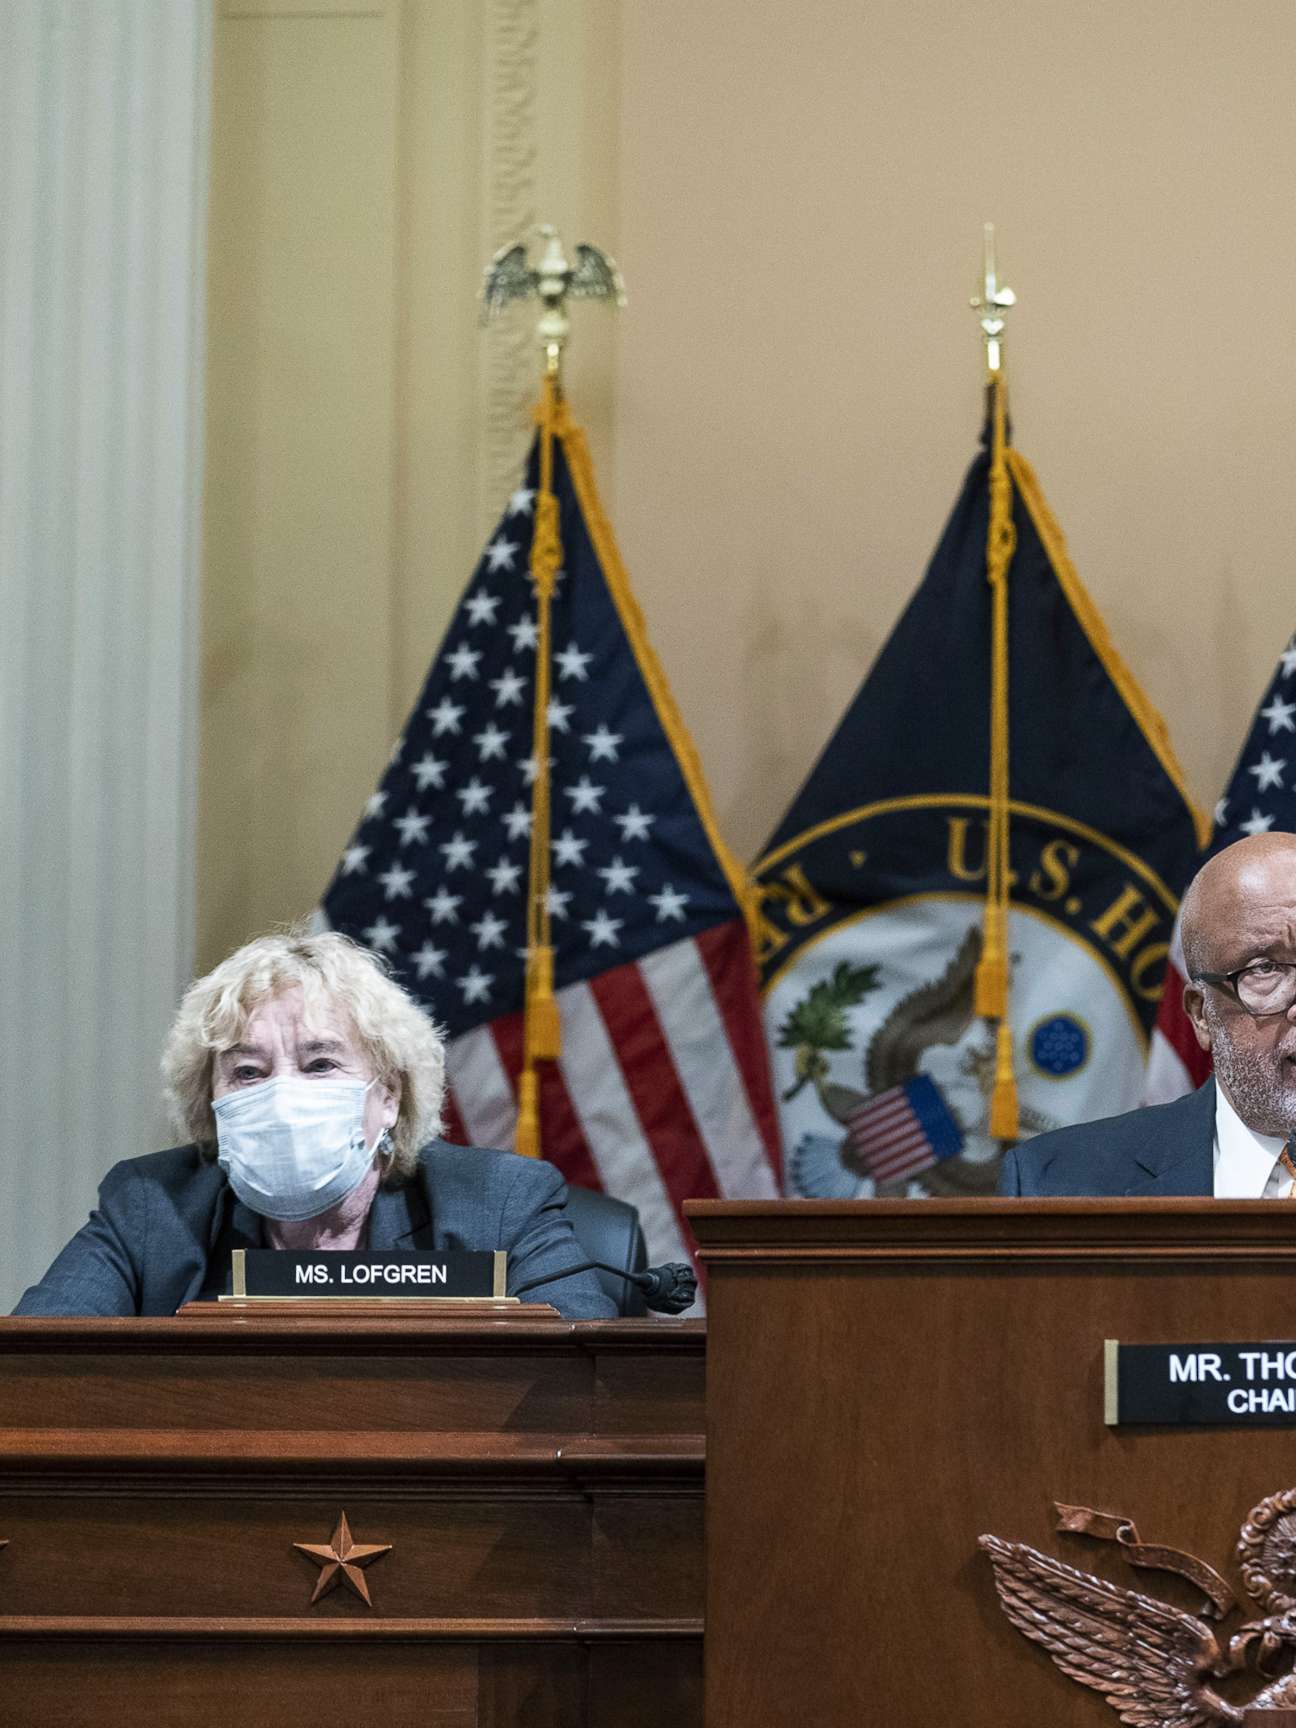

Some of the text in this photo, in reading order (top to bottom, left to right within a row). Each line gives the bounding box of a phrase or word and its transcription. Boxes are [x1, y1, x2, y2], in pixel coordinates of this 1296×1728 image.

[946, 816, 1083, 915] U.S.
[295, 1264, 447, 1284] MS. LOFGREN
[1169, 1353, 1231, 1382] MR.
